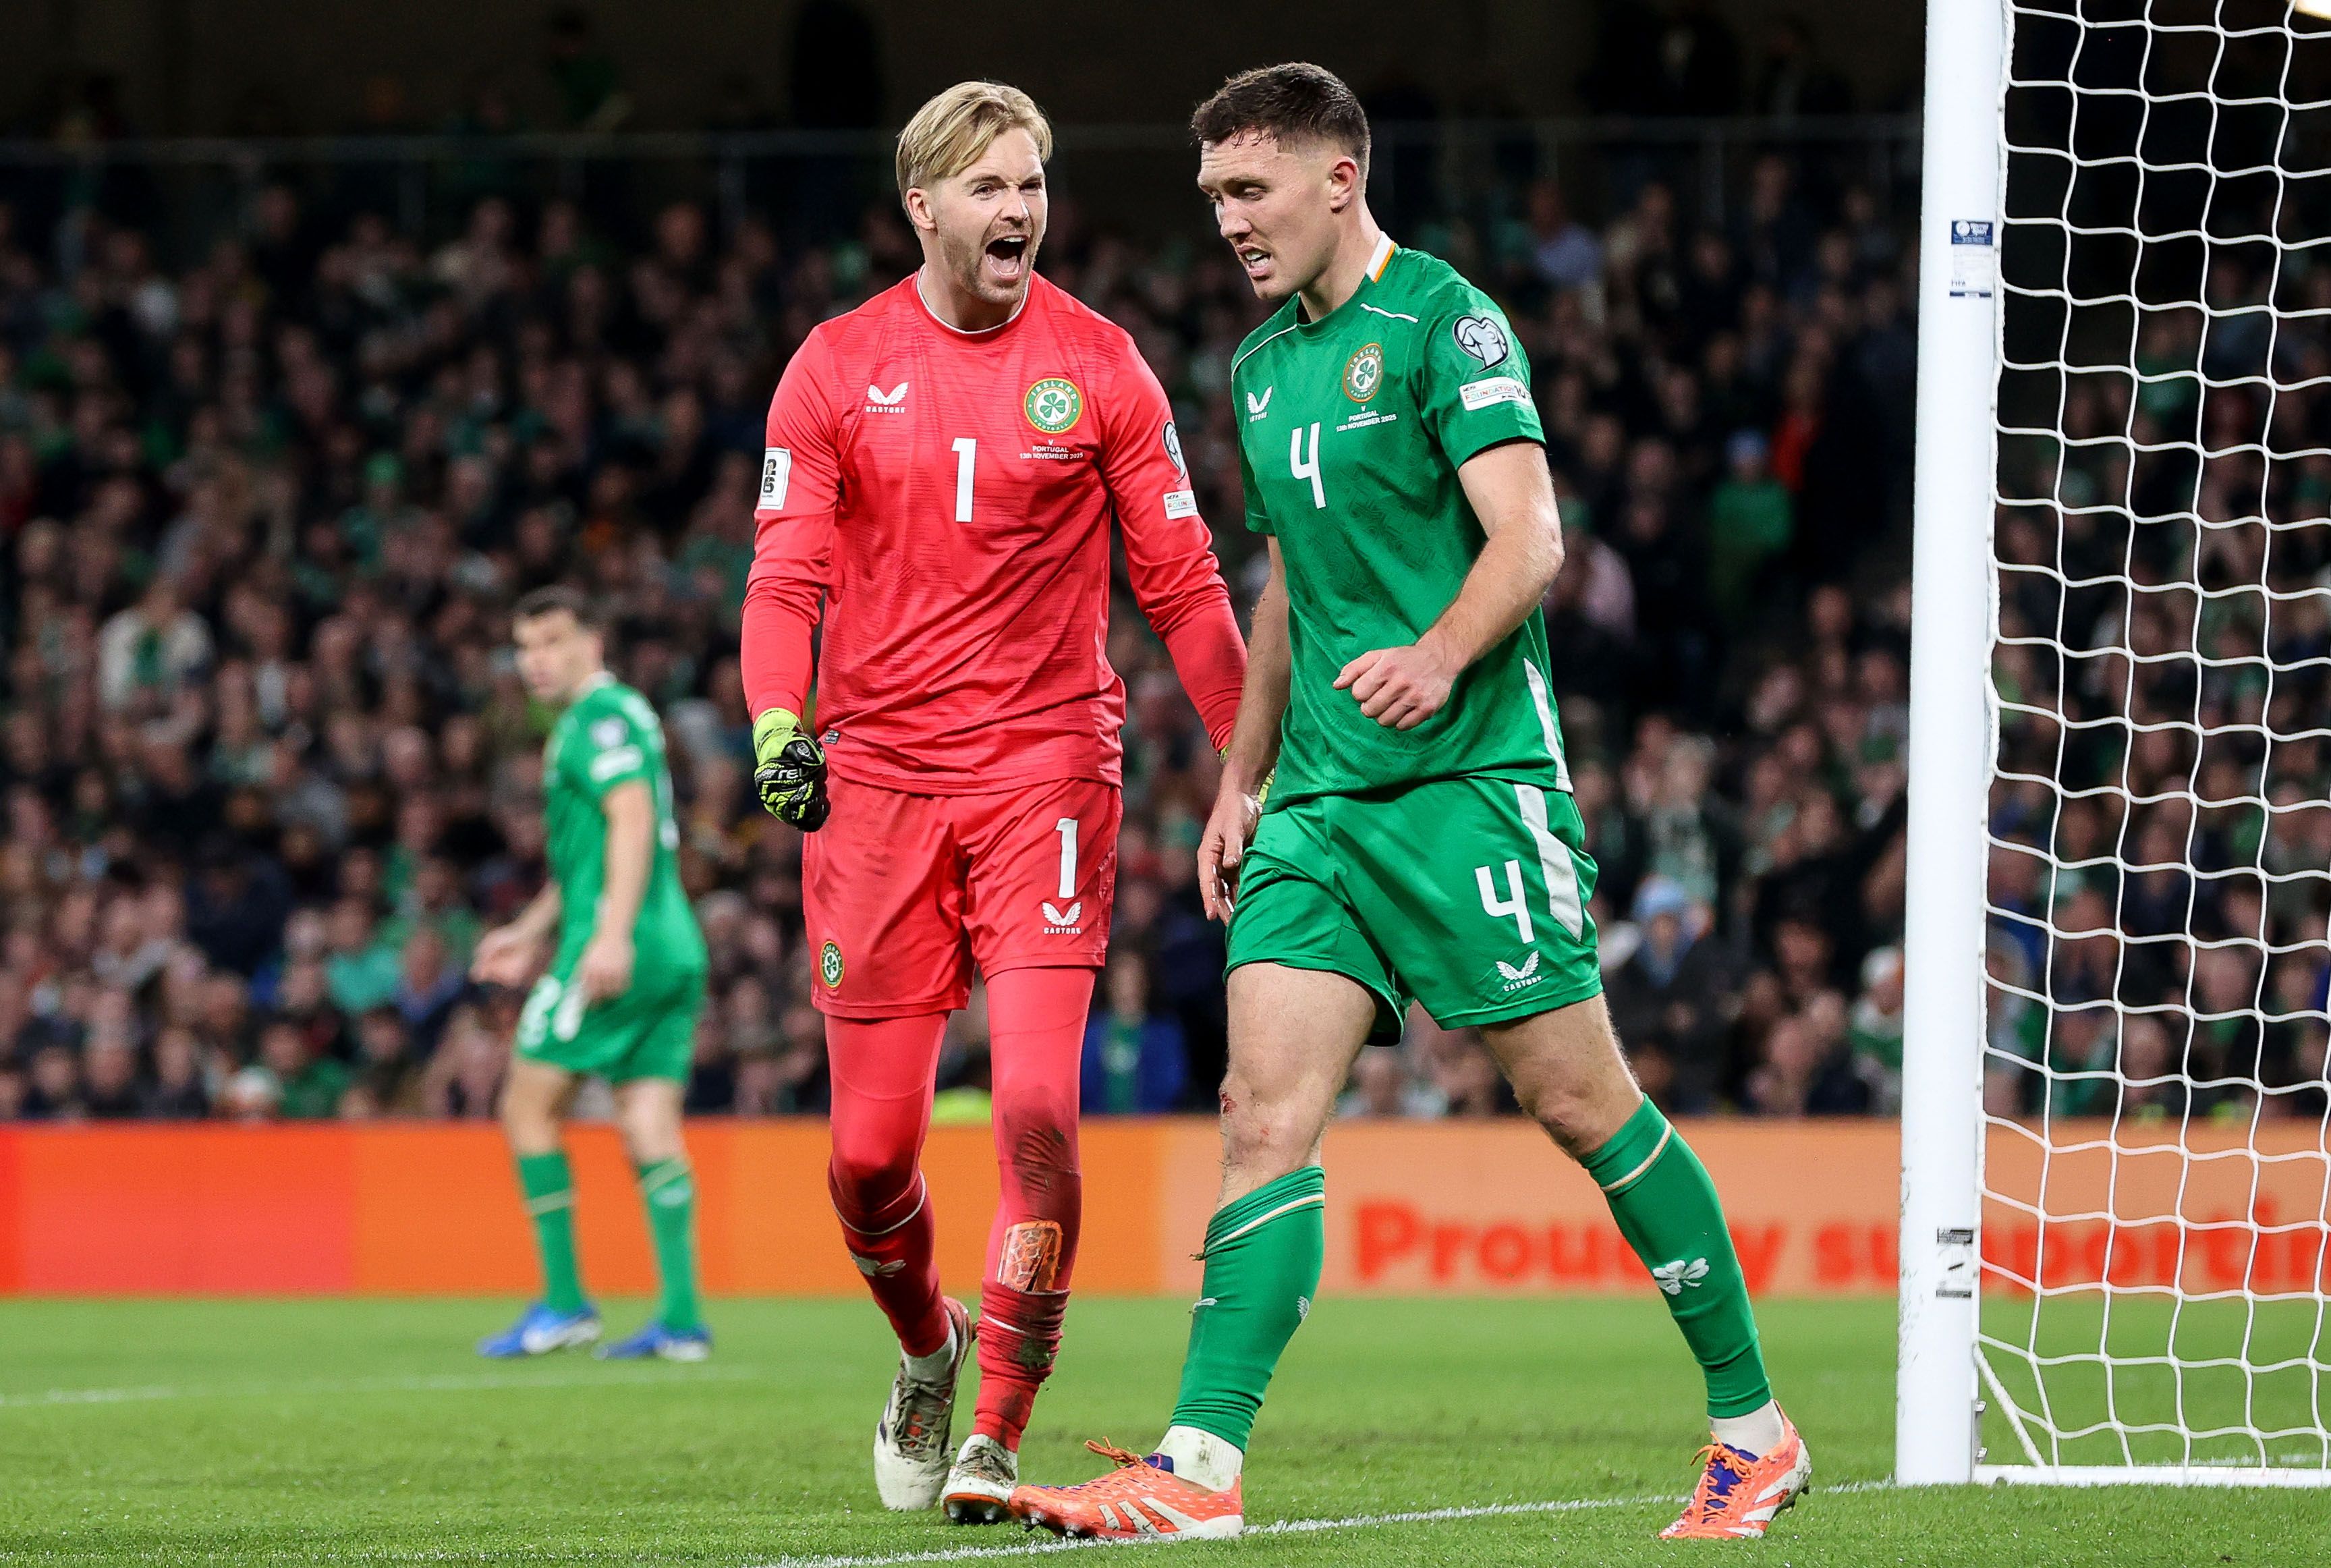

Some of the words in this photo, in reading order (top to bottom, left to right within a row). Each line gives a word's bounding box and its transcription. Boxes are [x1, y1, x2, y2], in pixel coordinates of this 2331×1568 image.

[1349, 347, 1382, 368] IRELAND
[1031, 381, 1077, 399] IRELAND
[866, 405, 905, 414] CASTORE
[1349, 410, 1379, 422] PORTUGAL
[1348, 417, 1380, 430] NOVEMBER
[1380, 414, 1397, 424] 2025
[1069, 451, 1084, 459] 2025
[1290, 421, 1326, 509] 4
[951, 437, 978, 522] 1
[1055, 817, 1079, 899] 1
[1474, 859, 1536, 944] 4
[1503, 976, 1542, 992] CASTORE
[1355, 1200, 1785, 1297] Prouy
